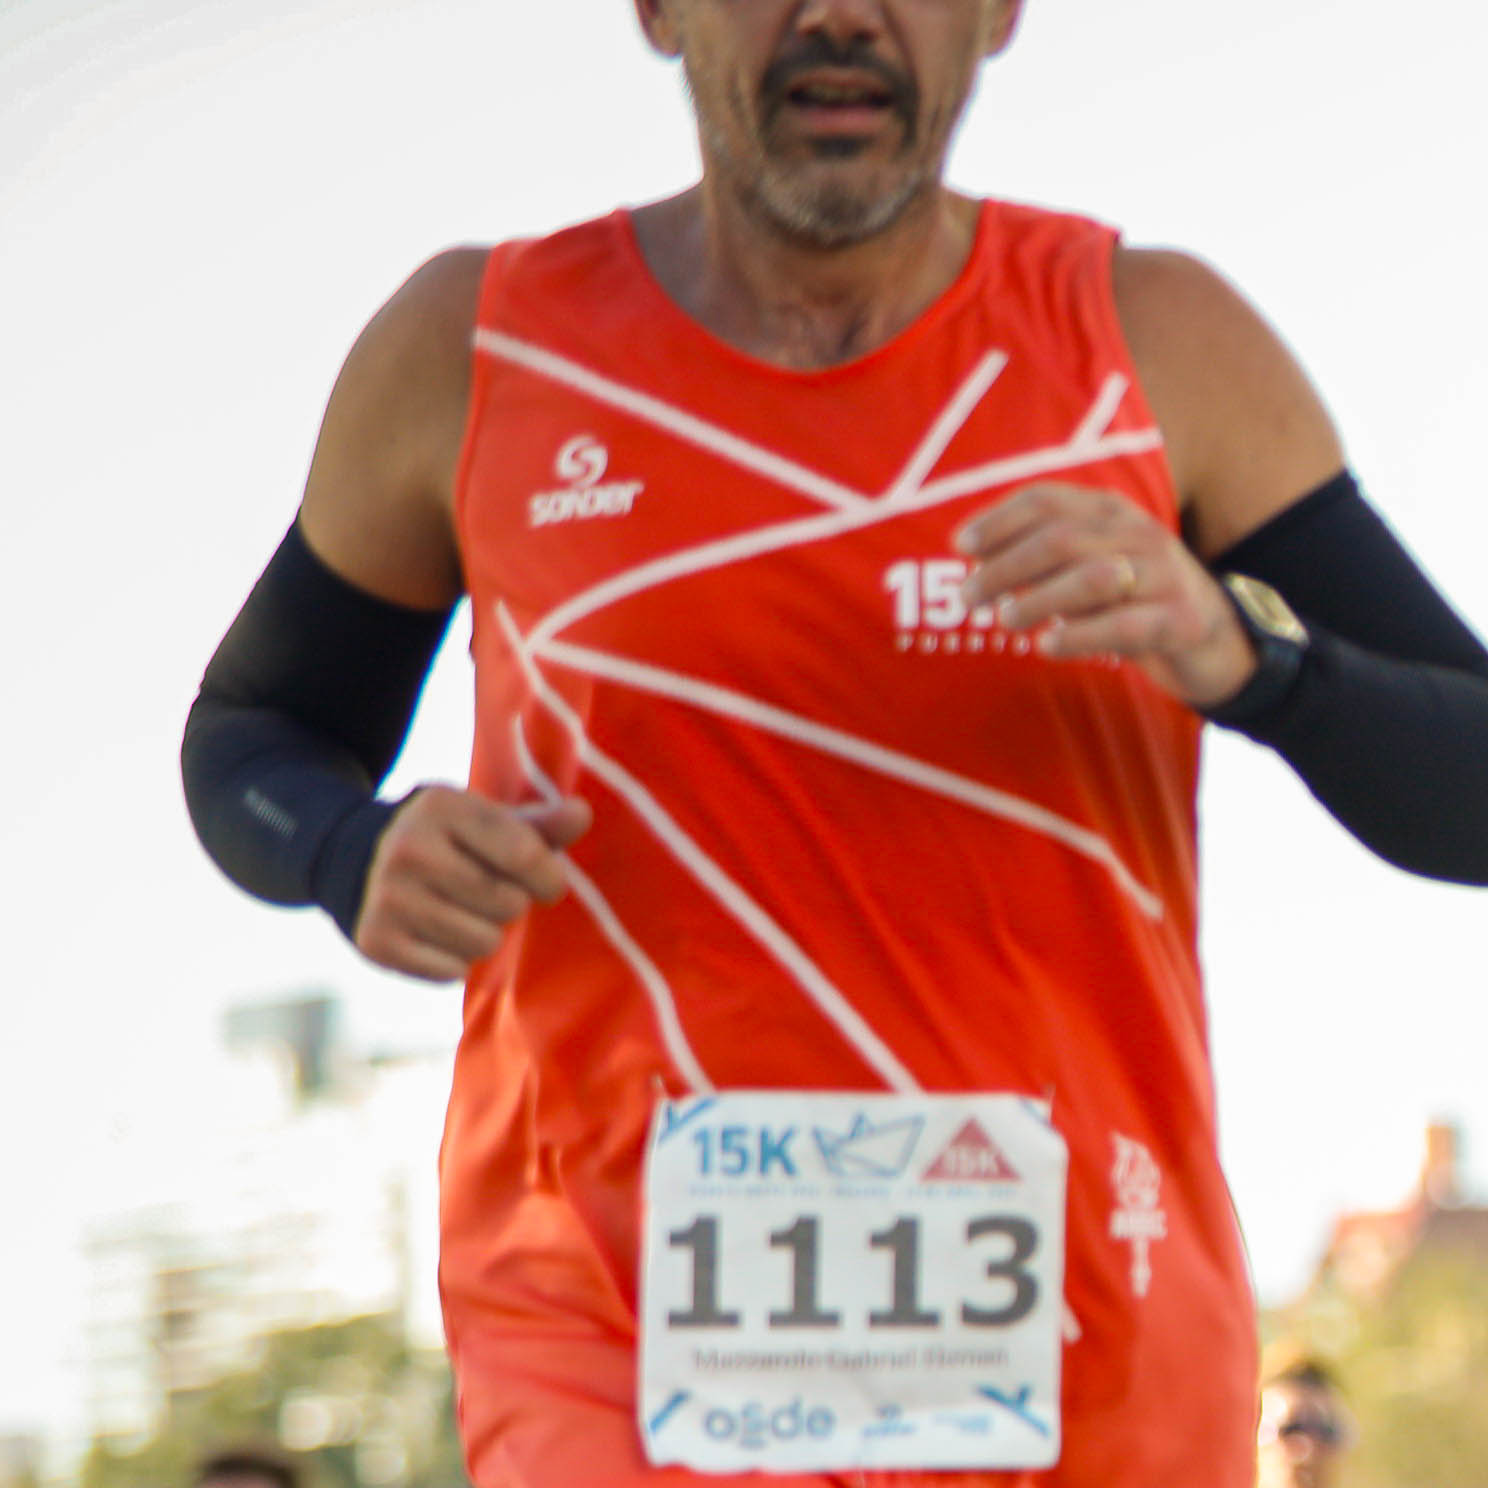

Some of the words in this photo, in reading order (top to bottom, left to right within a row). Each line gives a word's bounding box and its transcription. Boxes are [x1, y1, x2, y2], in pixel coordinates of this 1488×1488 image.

[884, 560, 995, 629] 15
[693, 1125, 797, 1178] 15K
[667, 1214, 1041, 1331] 1113
